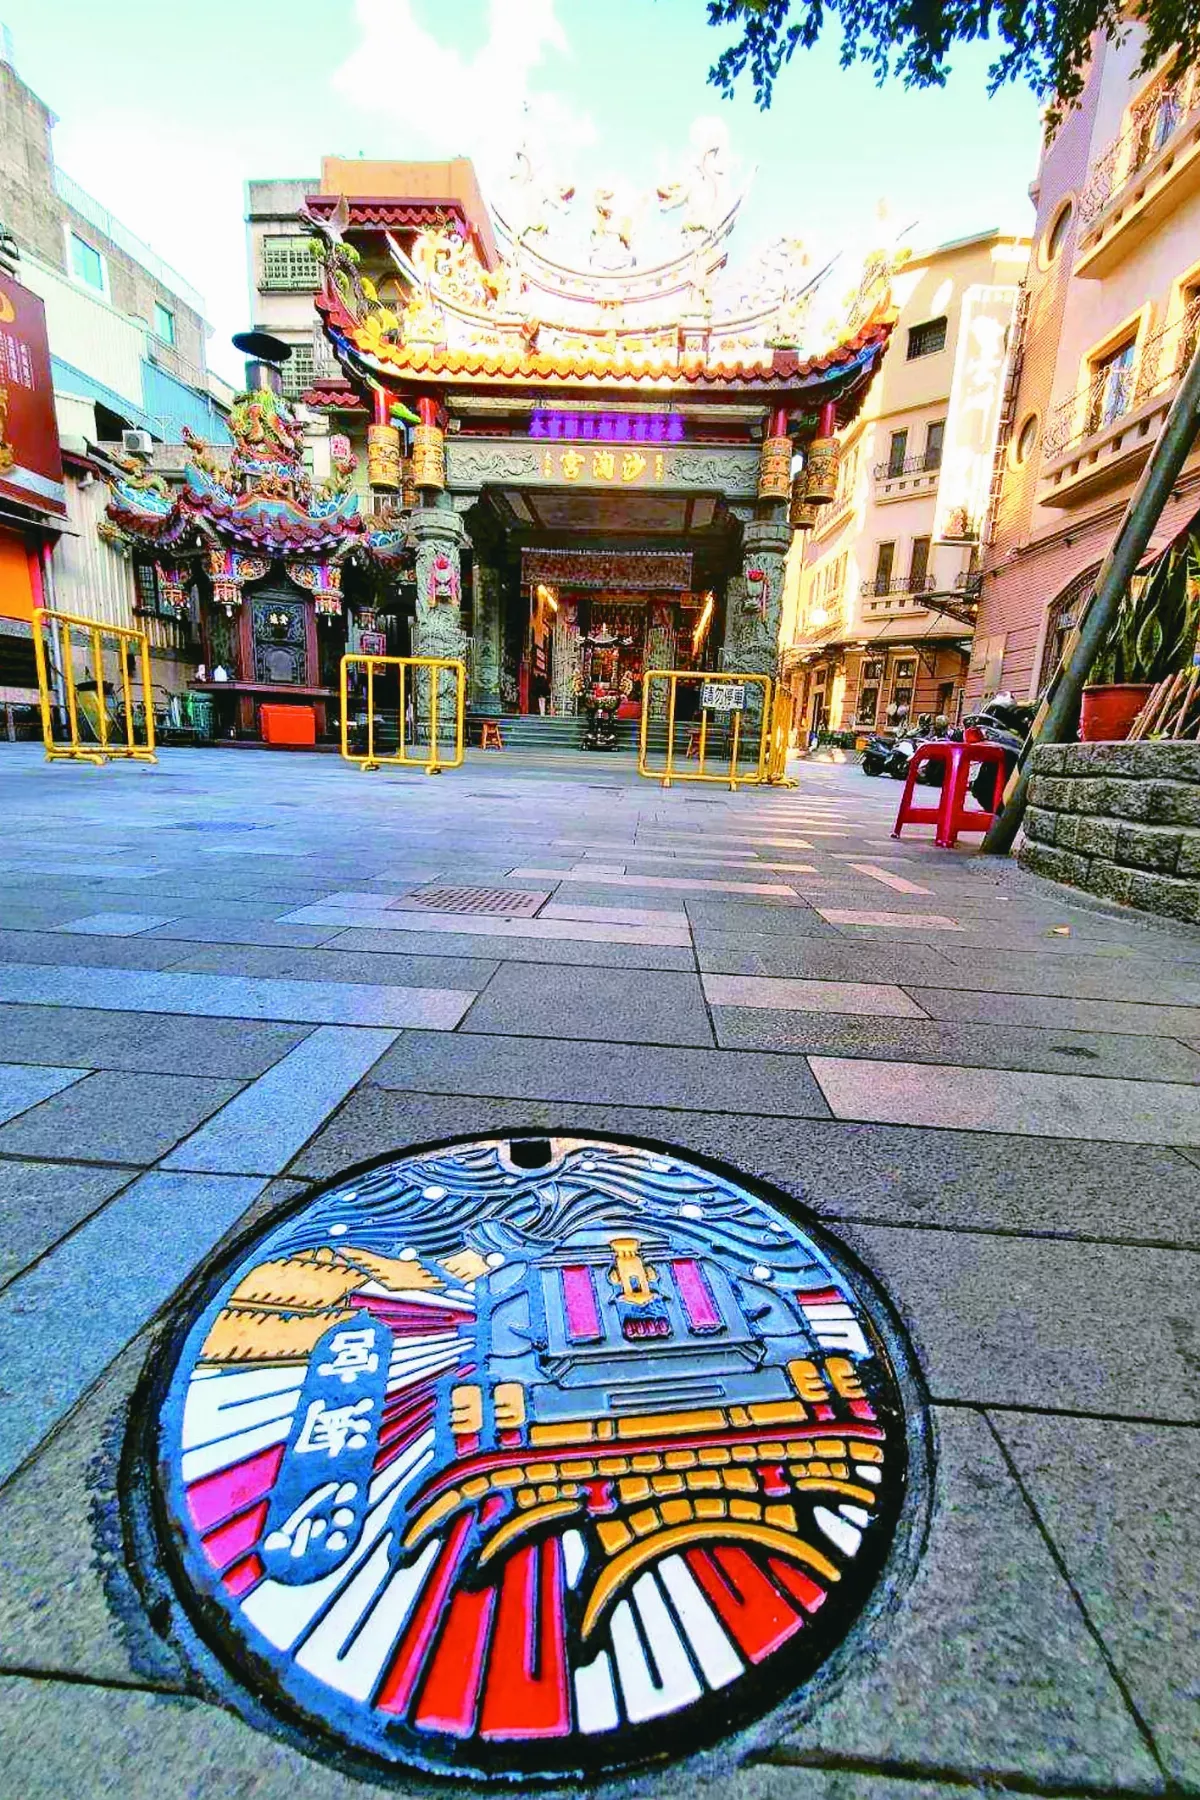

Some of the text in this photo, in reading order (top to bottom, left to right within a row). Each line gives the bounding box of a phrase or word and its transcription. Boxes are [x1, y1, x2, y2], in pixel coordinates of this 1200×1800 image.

[704, 685, 743, 706] 請勿停車
[263, 1328, 379, 1559] 沙淘宮
